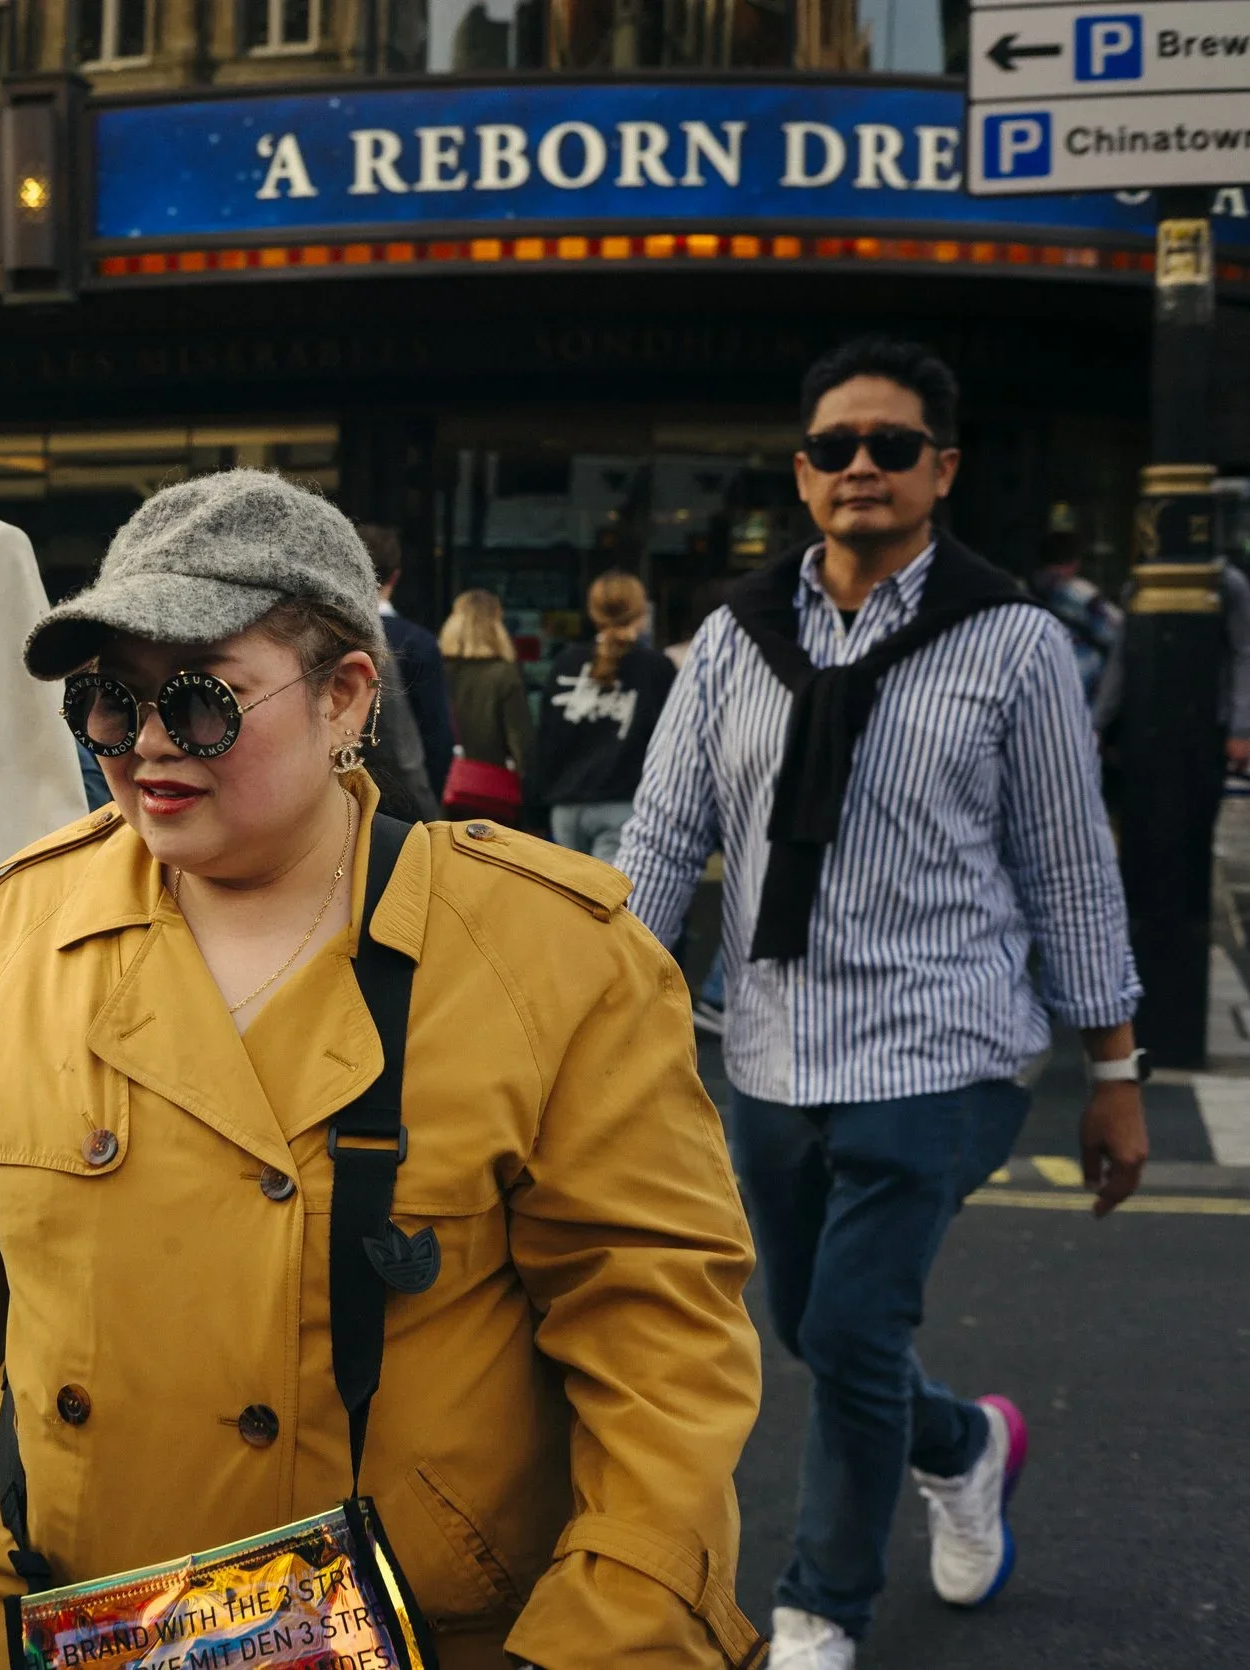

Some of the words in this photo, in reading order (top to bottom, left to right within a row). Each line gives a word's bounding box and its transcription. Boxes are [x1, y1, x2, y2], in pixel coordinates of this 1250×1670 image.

[1090, 21, 1134, 77] P
[1157, 30, 1250, 59] Brew
[348, 120, 747, 196] REBORN
[778, 121, 962, 192] DRE
[999, 118, 1043, 175] P
[161, 676, 231, 705] L'AVEUGLE
[74, 729, 95, 751] PAR
[102, 731, 136, 756] AMOUR
[168, 729, 190, 751] PAR
[198, 730, 235, 756] AMOUR
[63, 1625, 149, 1668] BRAND
[155, 1606, 217, 1644] WITH
[224, 1590, 273, 1623] THE
[278, 1585, 292, 1606] 3
[298, 1566, 356, 1602] STRI
[189, 1643, 231, 1670] MIT
[240, 1627, 292, 1662] DEN
[299, 1621, 314, 1645] 3
